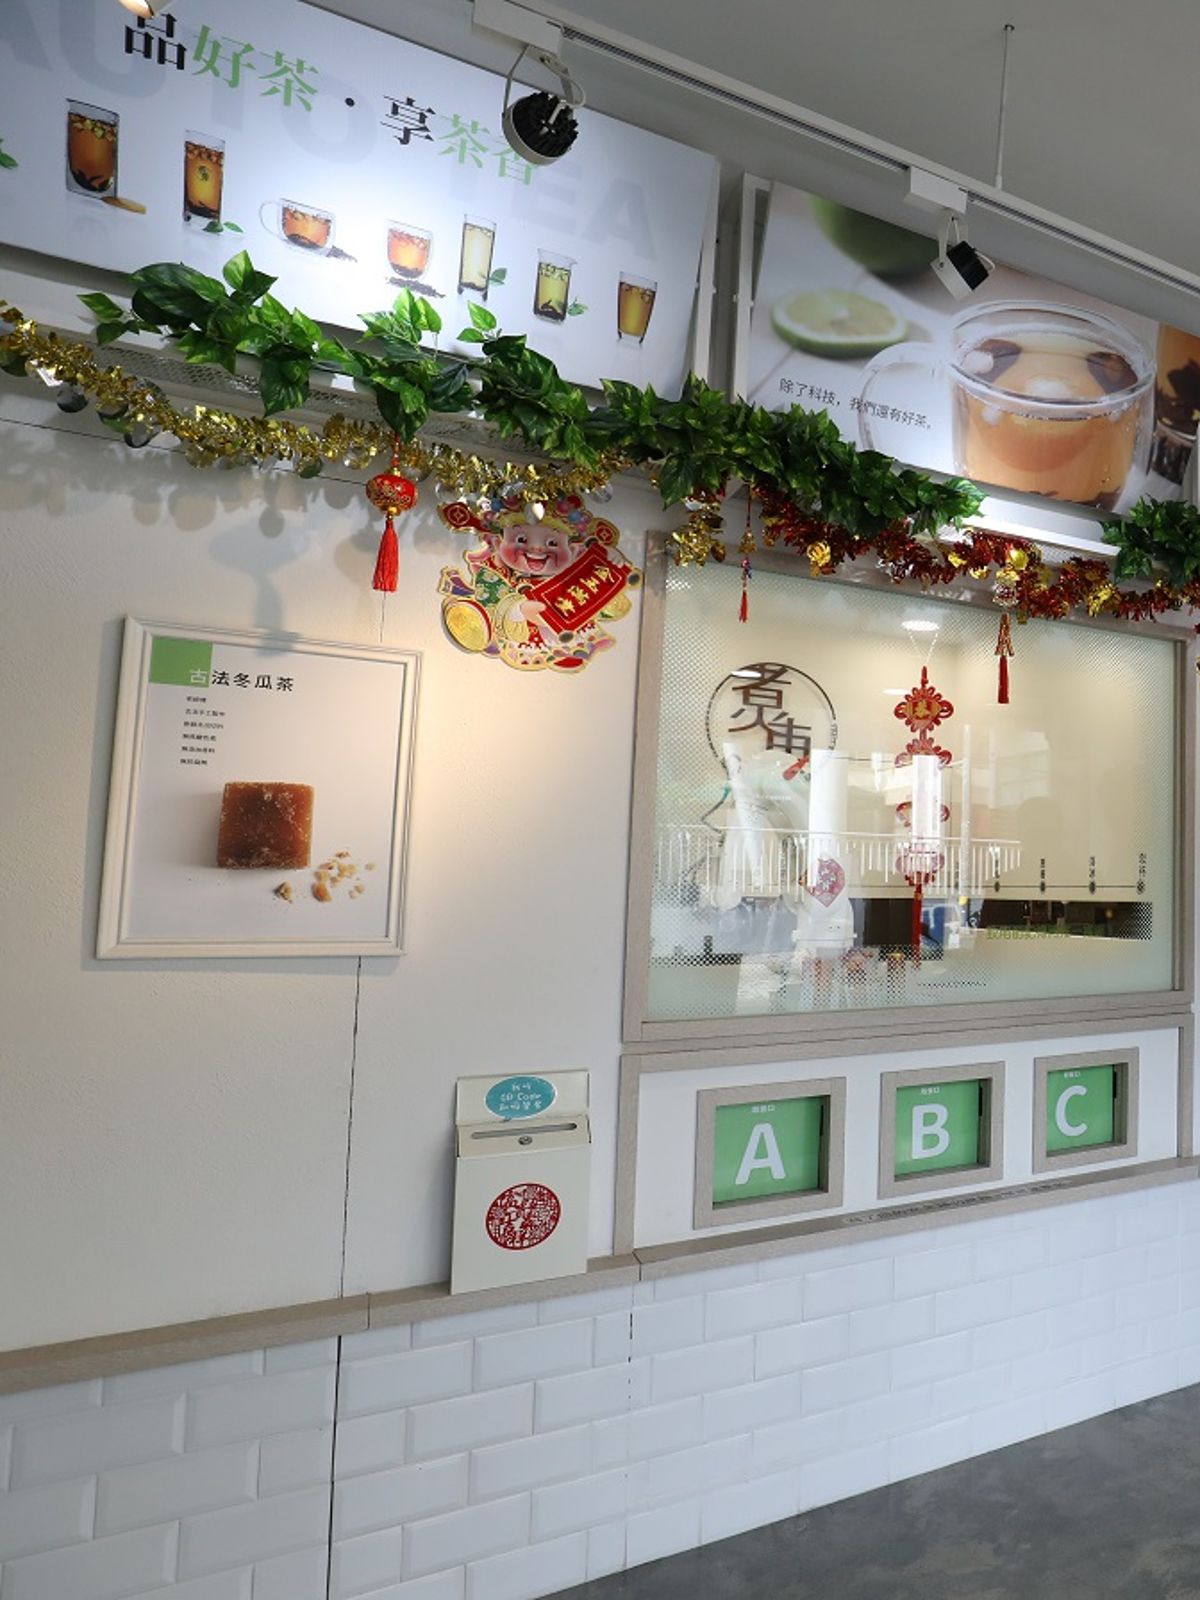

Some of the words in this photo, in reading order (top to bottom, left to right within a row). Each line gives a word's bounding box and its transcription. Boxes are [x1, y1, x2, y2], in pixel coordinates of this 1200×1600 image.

[189, 668, 294, 692] 古法冬瓜茶
[911, 1103, 951, 1160] B
[1054, 1085, 1088, 1137] C
[735, 1122, 786, 1185] A
